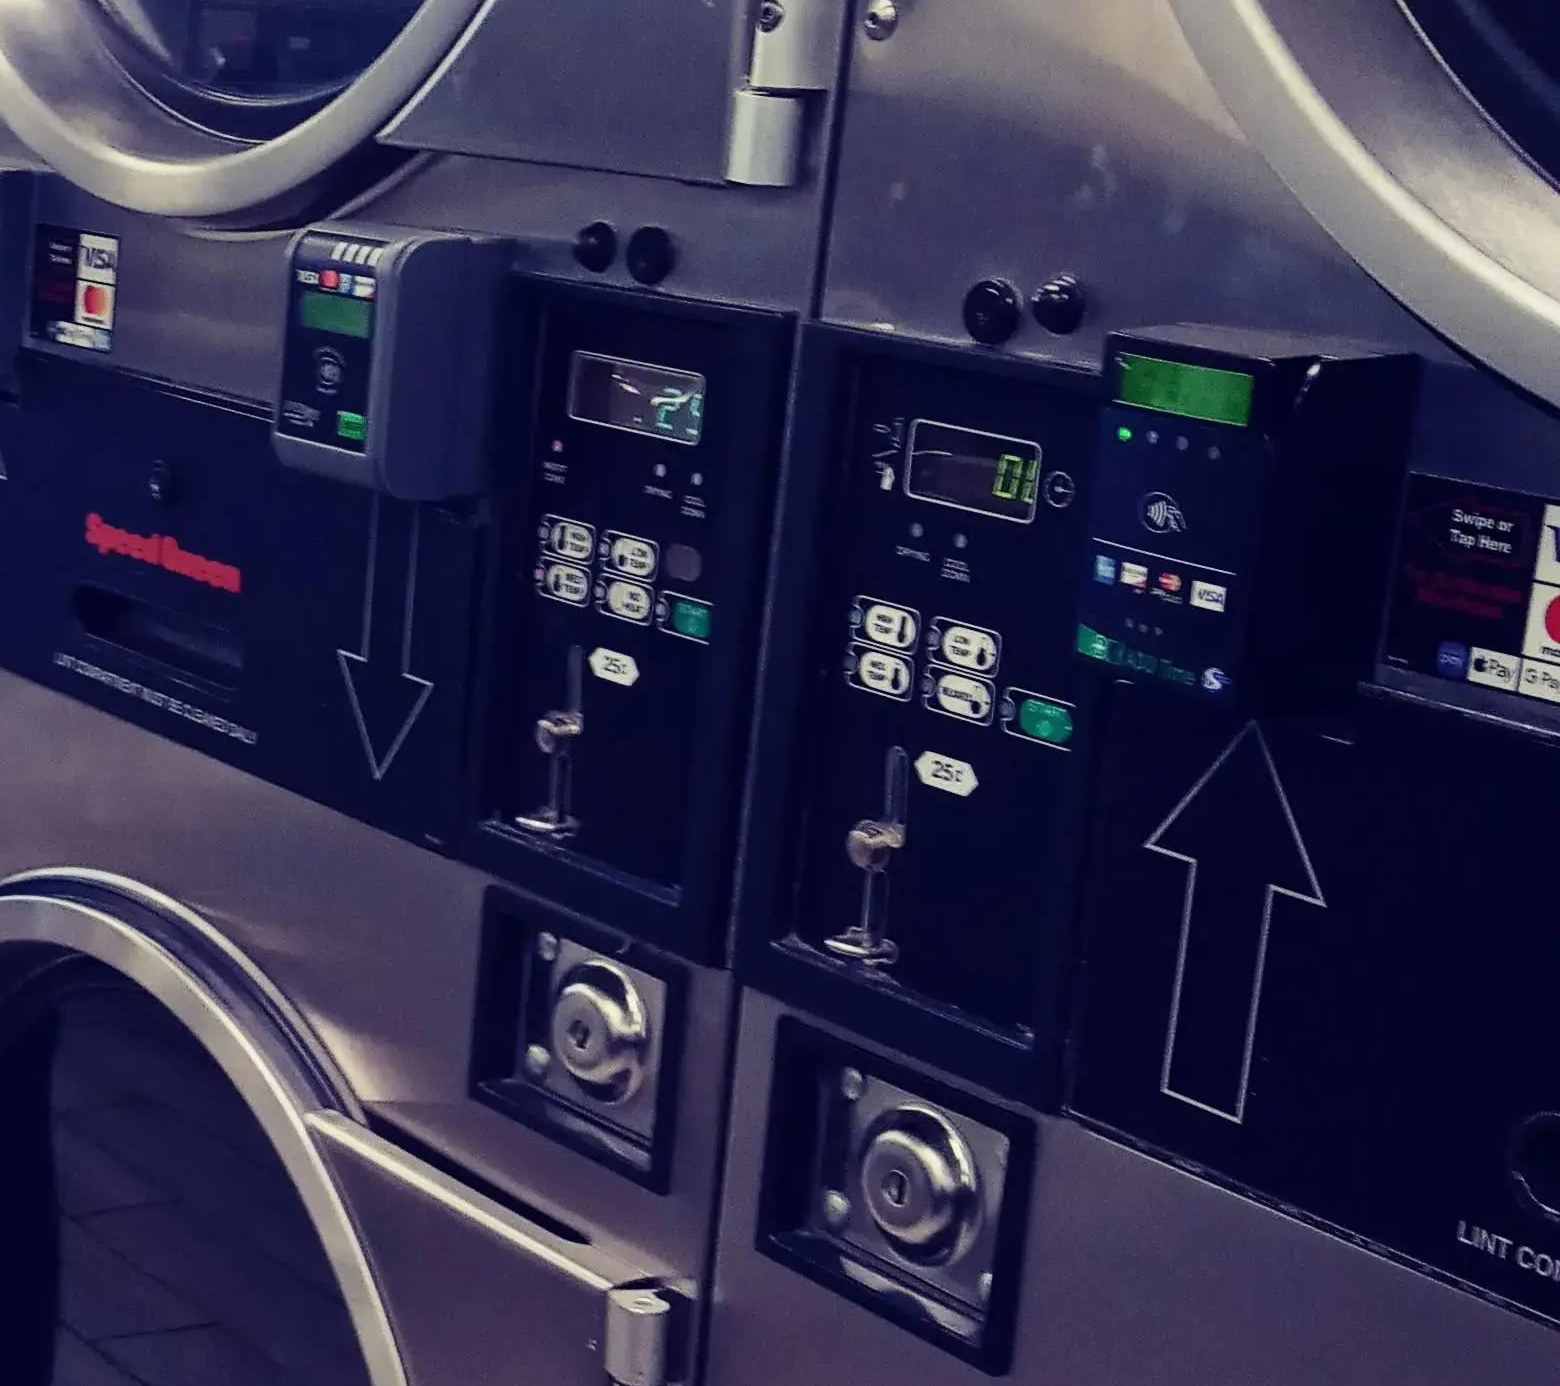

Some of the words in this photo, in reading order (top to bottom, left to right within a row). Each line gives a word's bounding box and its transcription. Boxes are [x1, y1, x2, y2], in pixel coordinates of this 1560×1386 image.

[1451, 509, 1496, 531] Swipe
[1496, 520, 1515, 533] or
[1449, 528, 1476, 549] Tap
[1476, 534, 1513, 554] Here
[1198, 588, 1225, 606] VISA
[1488, 658, 1512, 685] Pay
[1457, 1219, 1514, 1260] LINT
